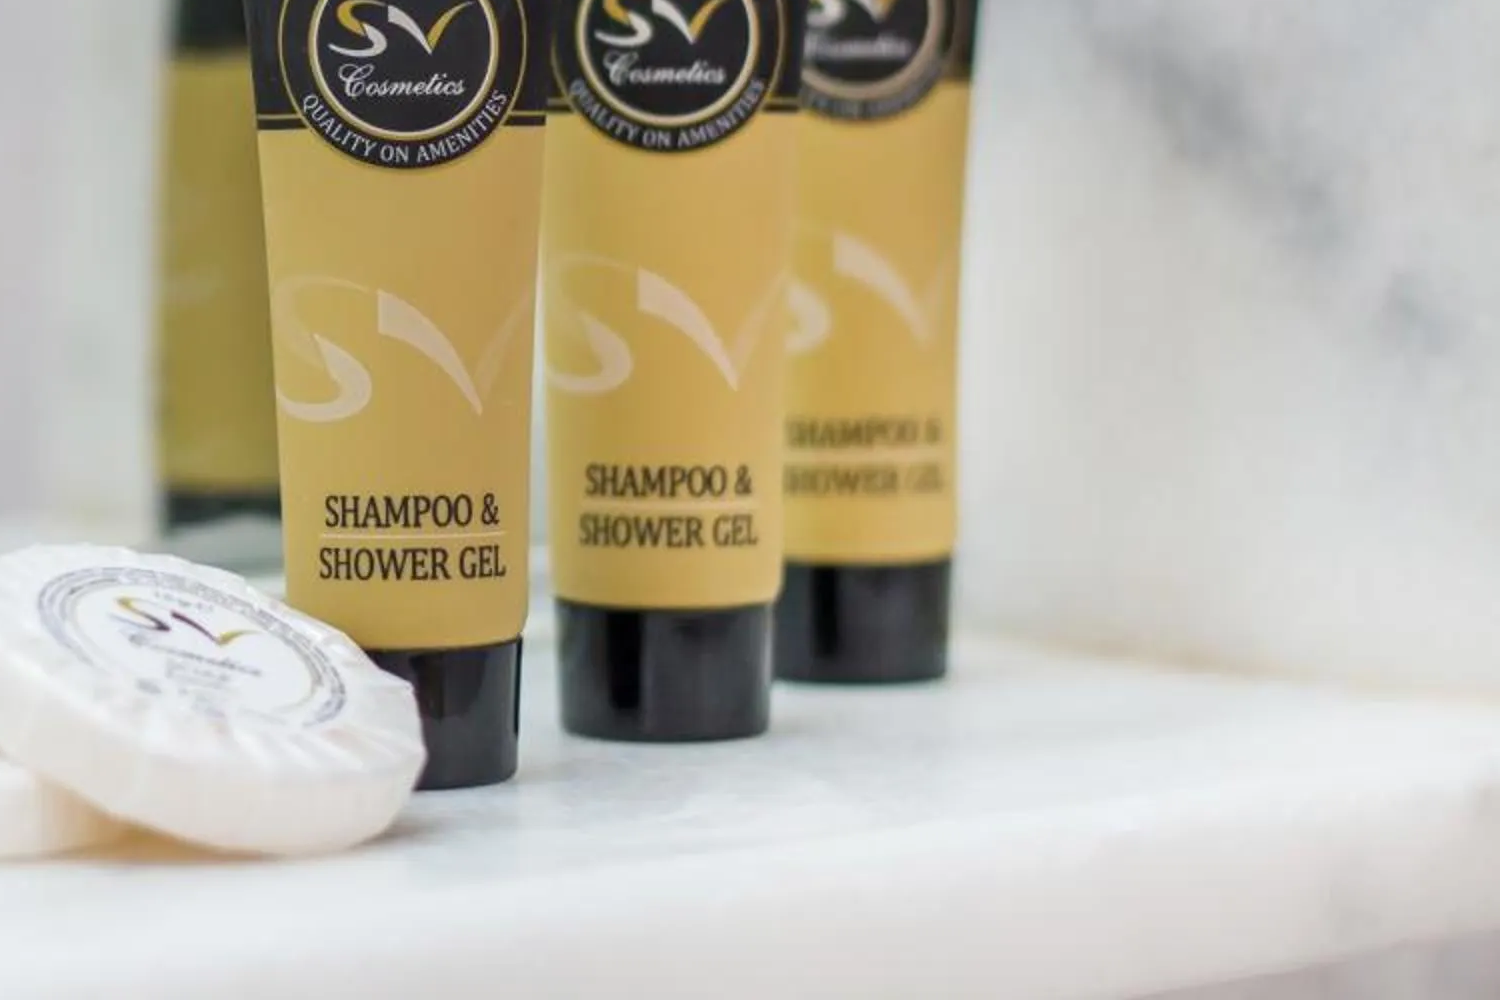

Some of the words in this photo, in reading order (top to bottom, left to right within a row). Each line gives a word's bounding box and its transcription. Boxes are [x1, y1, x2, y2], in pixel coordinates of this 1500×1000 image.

[338, 63, 467, 98] Cosmetics
[603, 51, 727, 86] Cosmetics
[302, 93, 377, 158] QUALITY
[380, 145, 410, 164] ON
[416, 88, 508, 164] AMENITIES
[569, 77, 640, 141] QUALITY
[642, 130, 672, 148] ON
[677, 78, 766, 149] AMENITIES
[271, 274, 533, 424] SV
[584, 464, 728, 498] SHAMPOO
[733, 463, 753, 495] &
[324, 494, 474, 529] SHAMPOO
[481, 492, 501, 526] &
[578, 512, 704, 549] SHOWER
[712, 512, 759, 548] GEL
[318, 546, 453, 581] SHOWER
[458, 544, 507, 580] GEL
